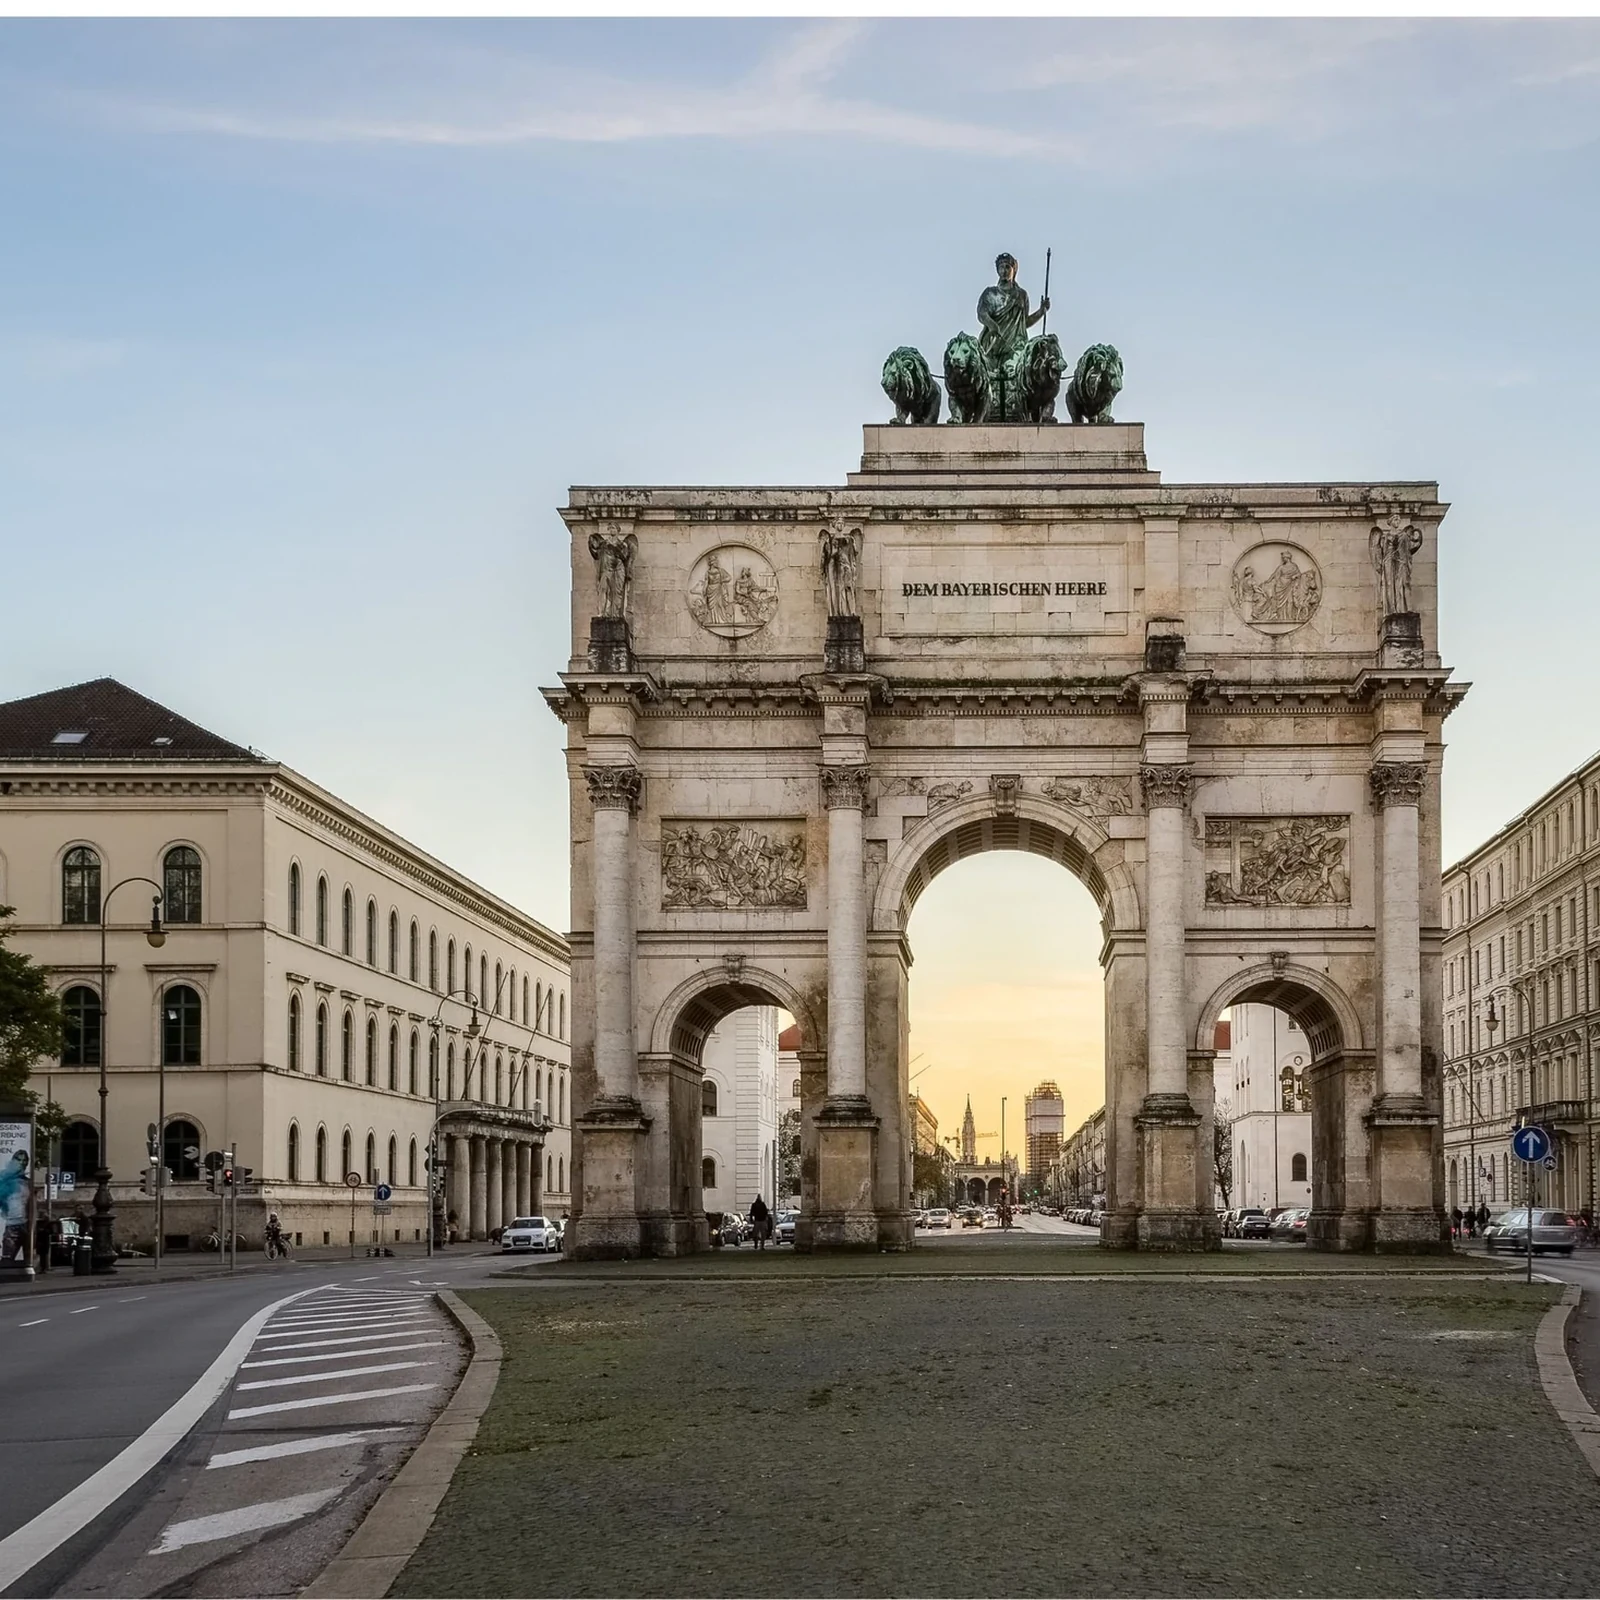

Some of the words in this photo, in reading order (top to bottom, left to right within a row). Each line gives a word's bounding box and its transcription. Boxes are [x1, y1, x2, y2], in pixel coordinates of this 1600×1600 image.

[902, 582, 938, 597] DEM
[941, 582, 1052, 597] BAYERISCHEN
[1054, 582, 1107, 597] HEERE
